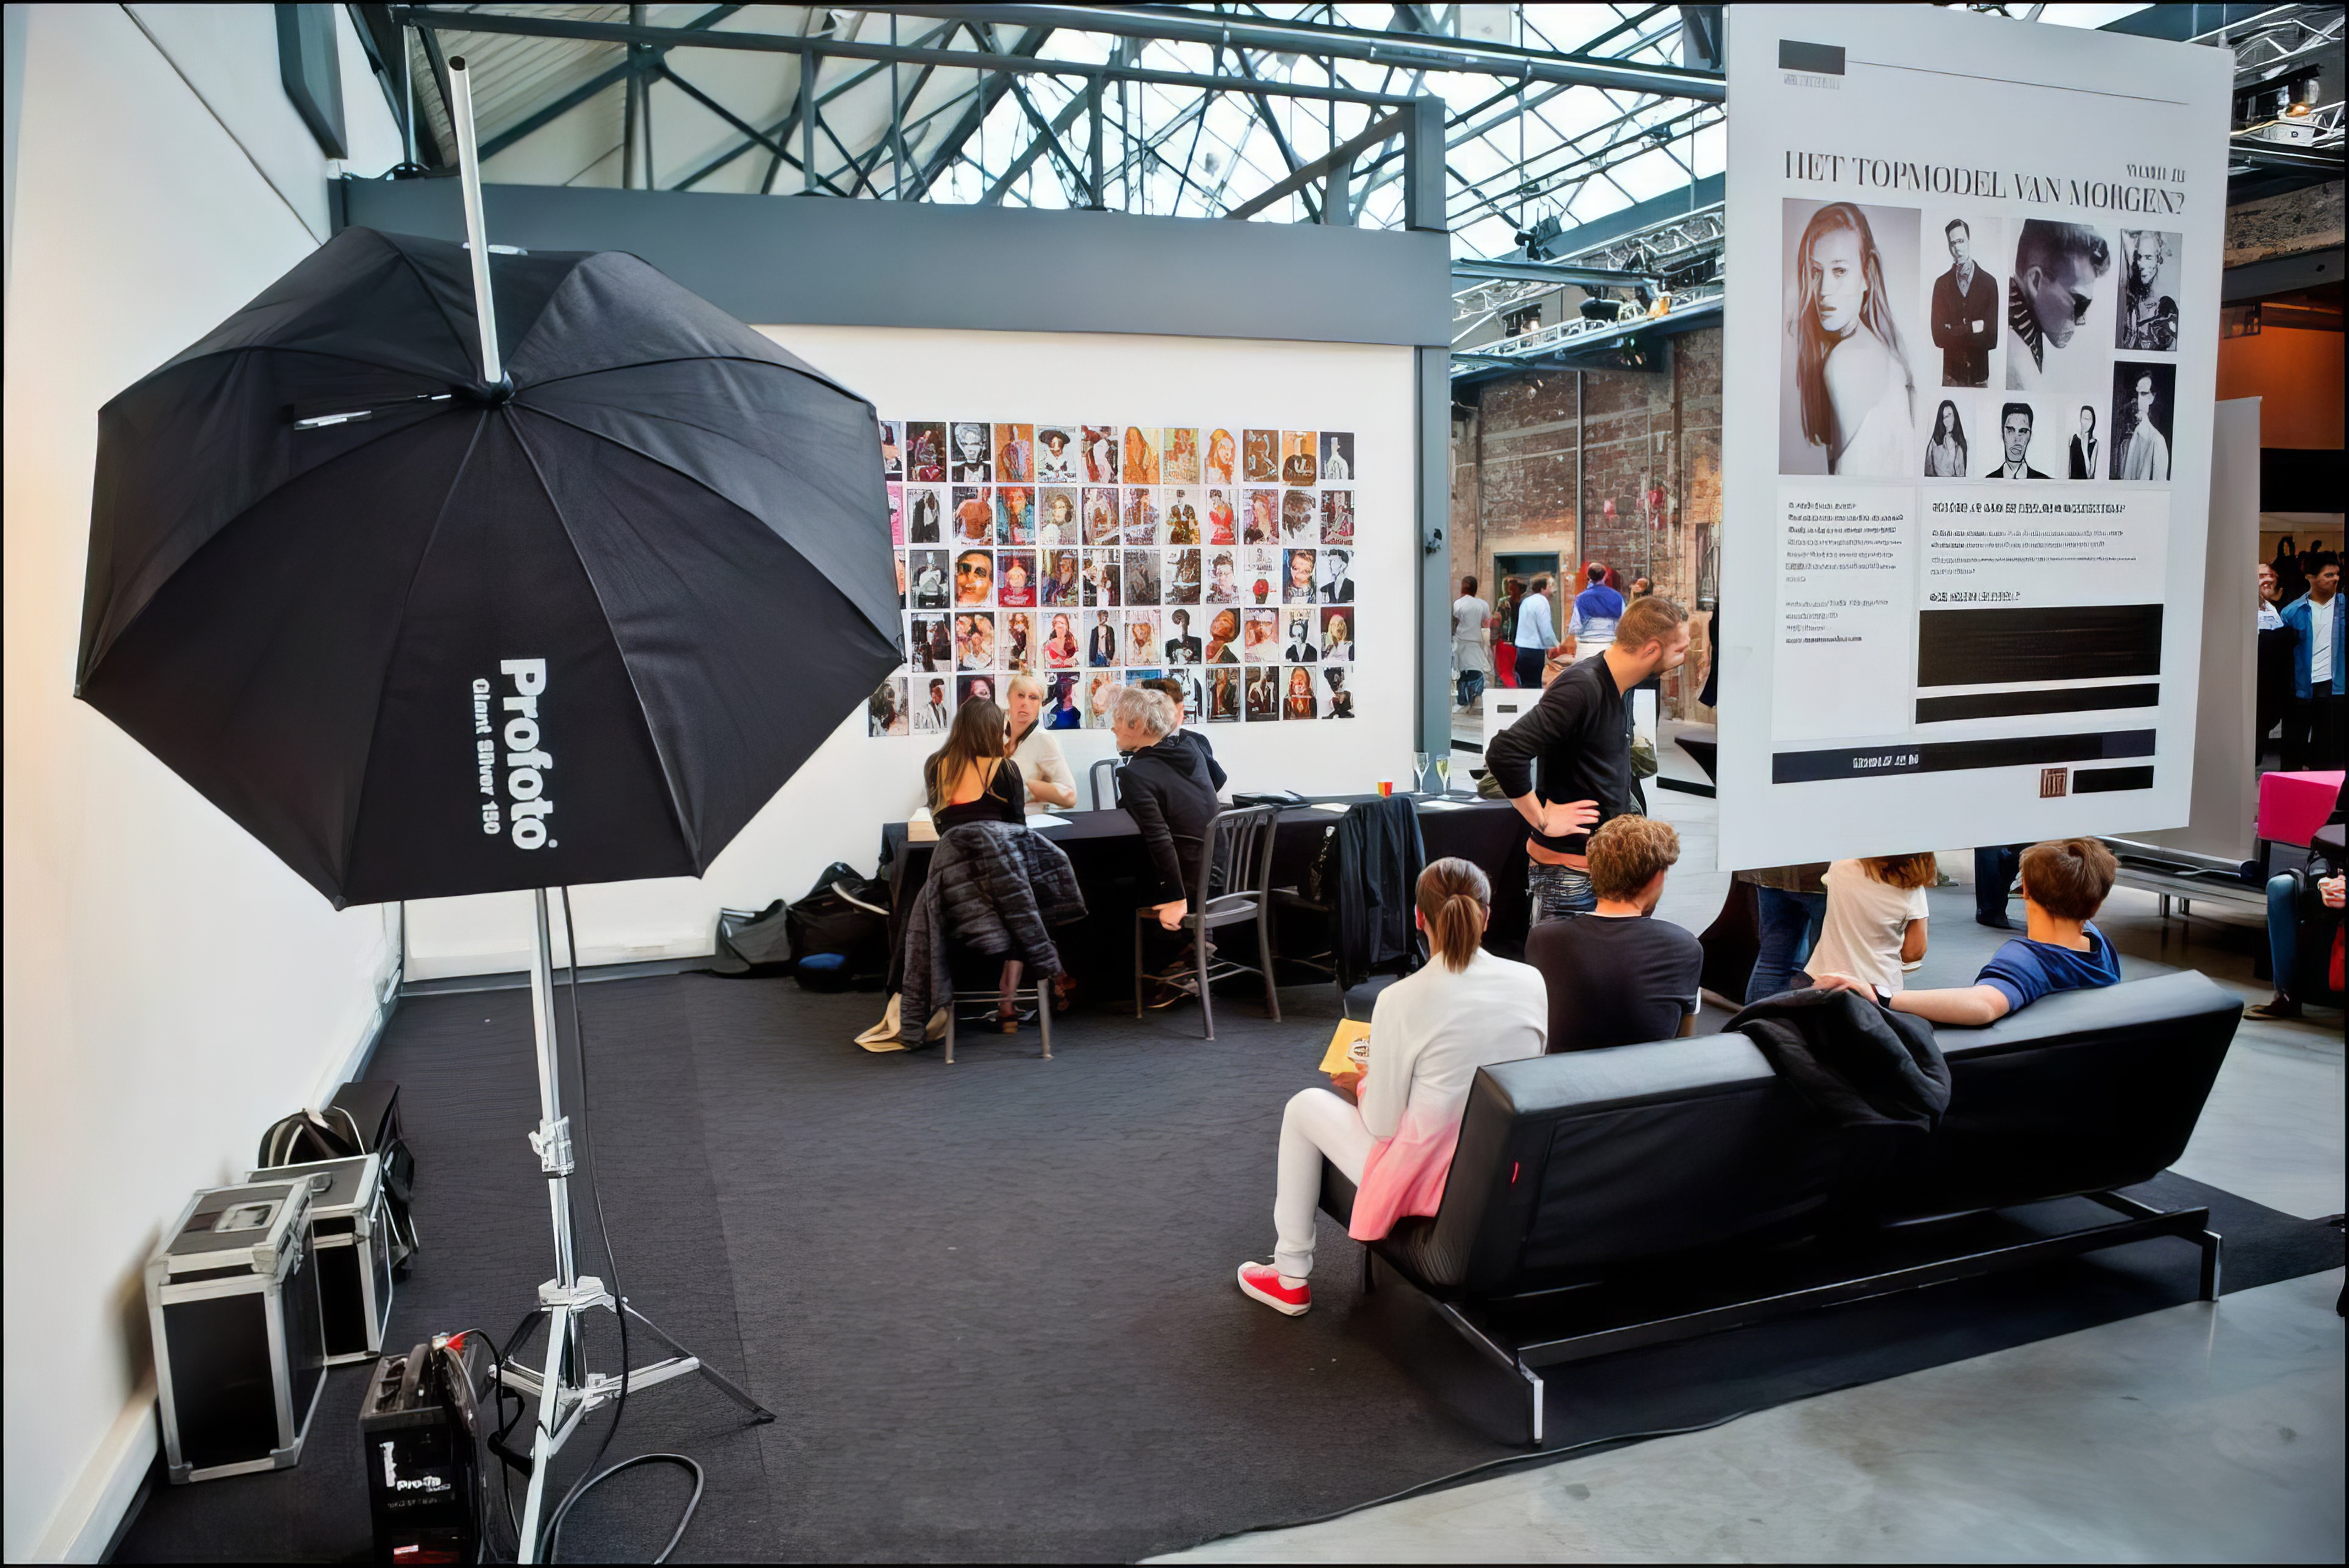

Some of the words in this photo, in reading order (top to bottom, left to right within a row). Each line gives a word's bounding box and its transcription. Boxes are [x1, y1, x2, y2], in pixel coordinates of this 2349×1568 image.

[1786, 150, 1845, 182] HET
[1852, 157, 2007, 199] TOPMODEL
[2013, 173, 2061, 204] VAN
[500, 659, 554, 849] Profoto
[482, 801, 500, 834] 150
